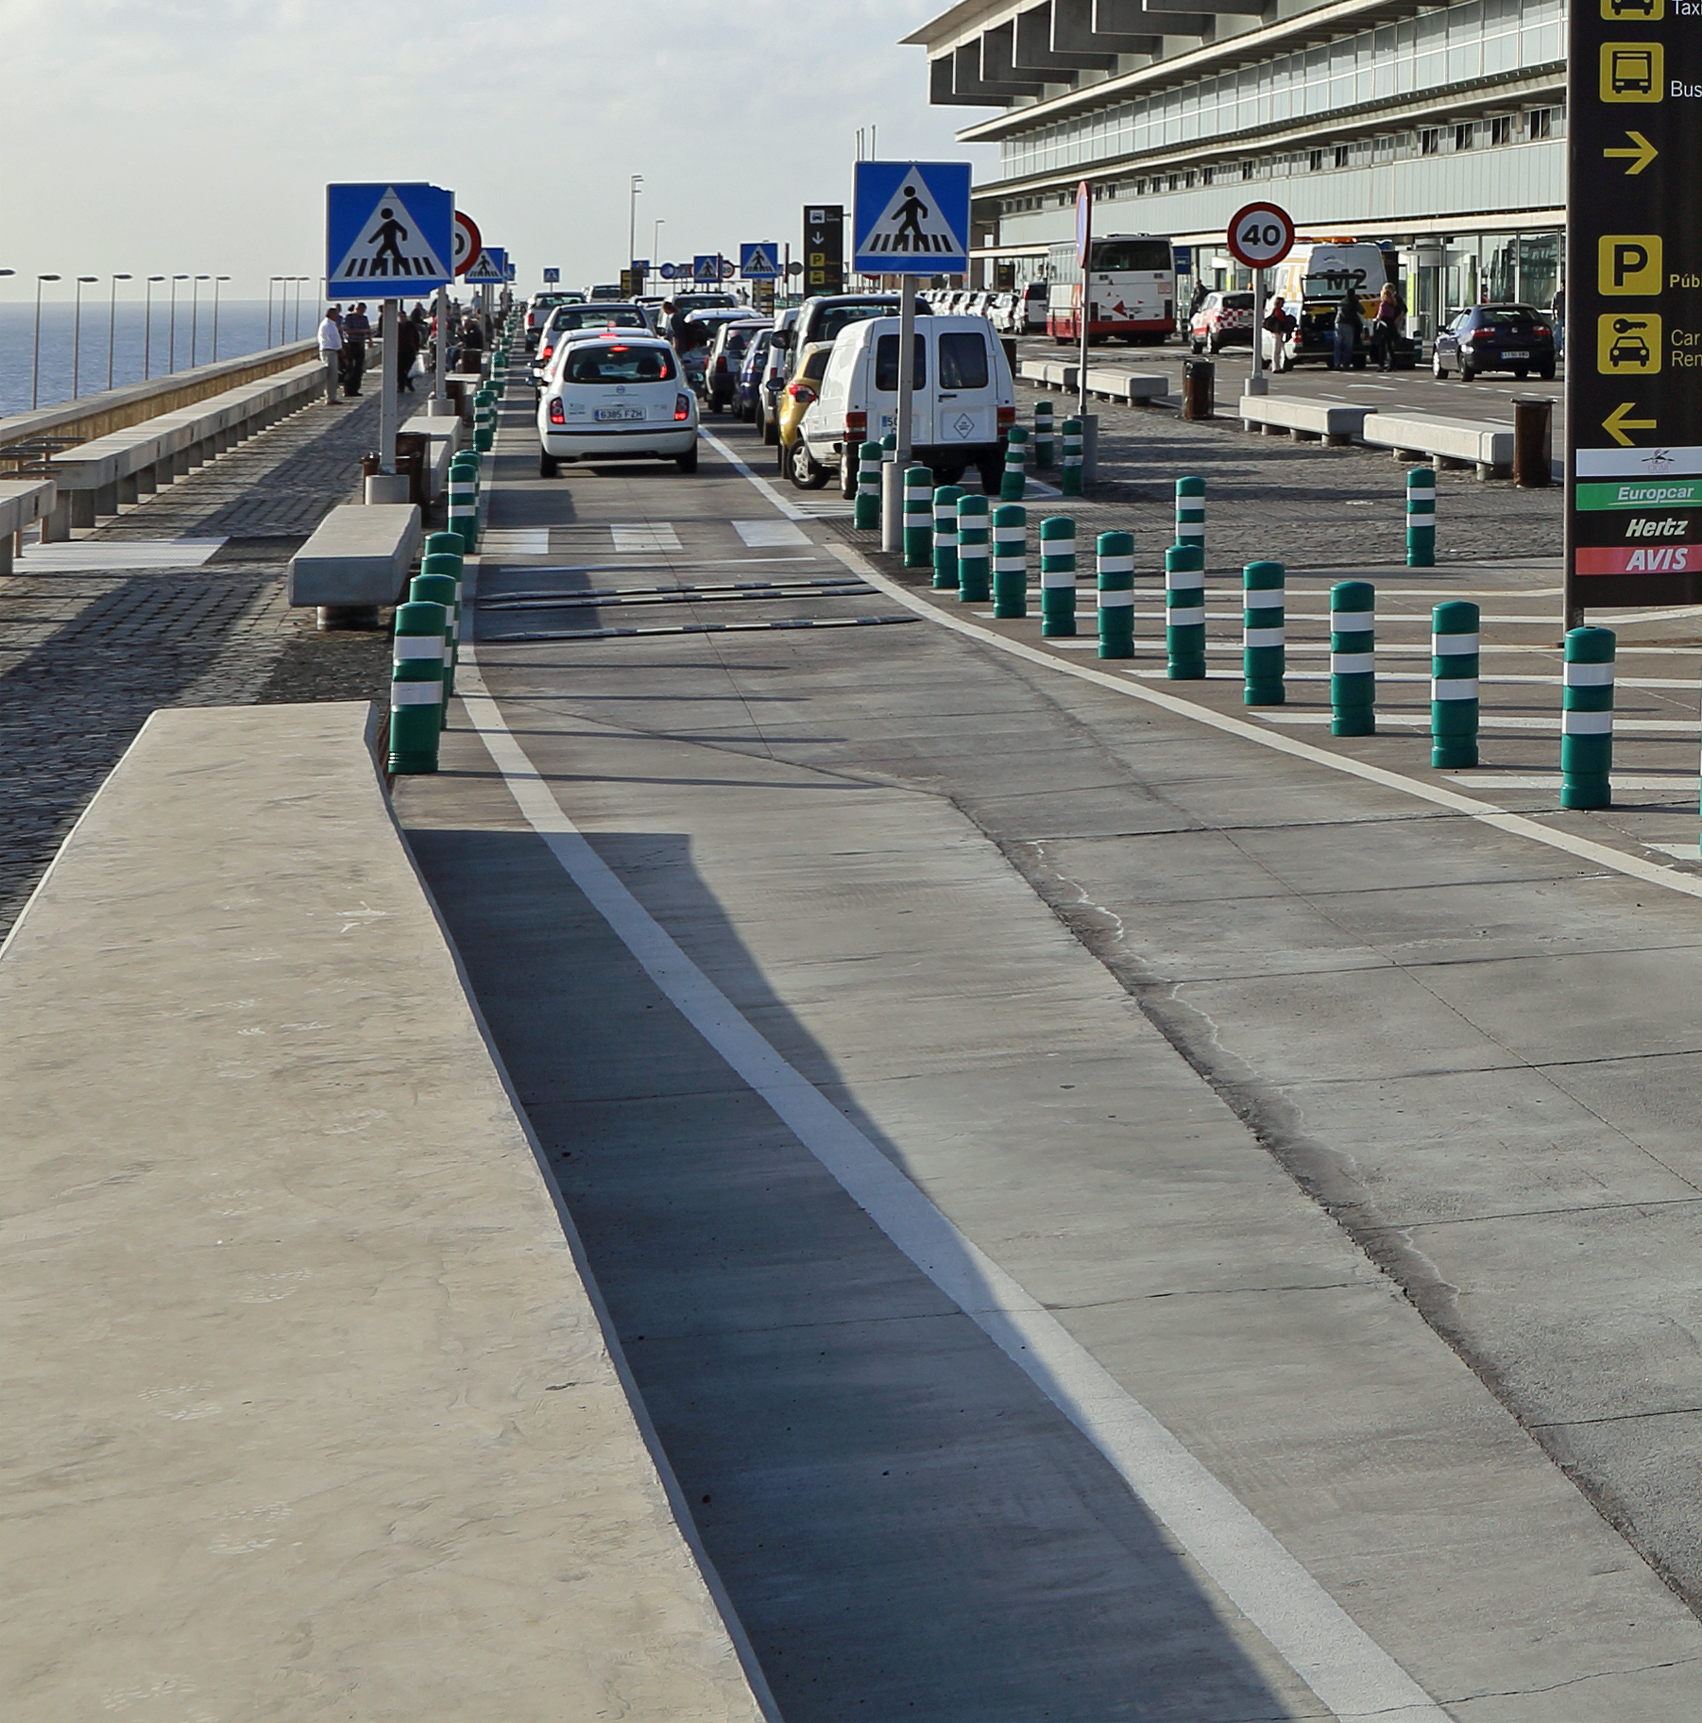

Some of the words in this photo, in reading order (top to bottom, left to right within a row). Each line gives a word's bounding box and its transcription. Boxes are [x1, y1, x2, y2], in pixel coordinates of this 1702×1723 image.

[1670, 80, 1702, 98] Bus
[1241, 224, 1281, 247] 40
[1613, 244, 1649, 287] P
[1670, 329, 1701, 347] Car
[1617, 486, 1695, 504] Europcar
[1625, 517, 1689, 538] Hertz
[1625, 547, 1689, 572] AVIS
